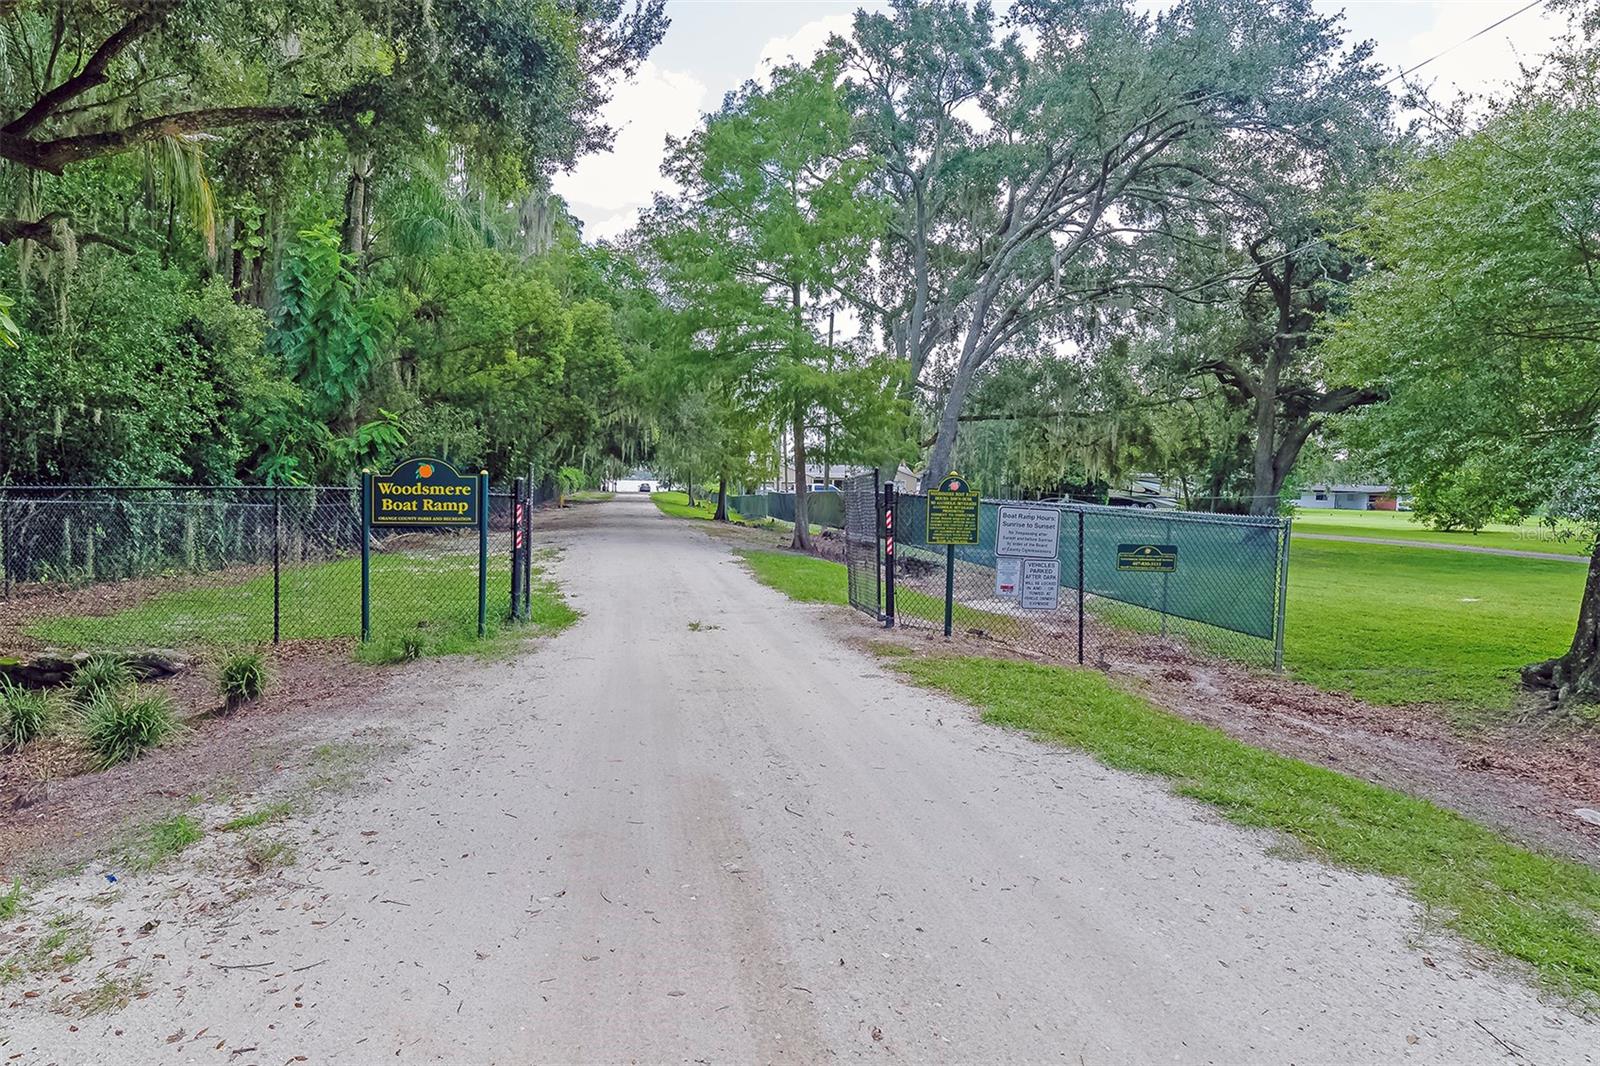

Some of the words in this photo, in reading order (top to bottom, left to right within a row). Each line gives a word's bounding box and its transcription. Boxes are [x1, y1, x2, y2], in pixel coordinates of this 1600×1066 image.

[378, 482, 471, 496] Woodsmere
[382, 498, 418, 511] Boat
[422, 498, 468, 514] Ramp
